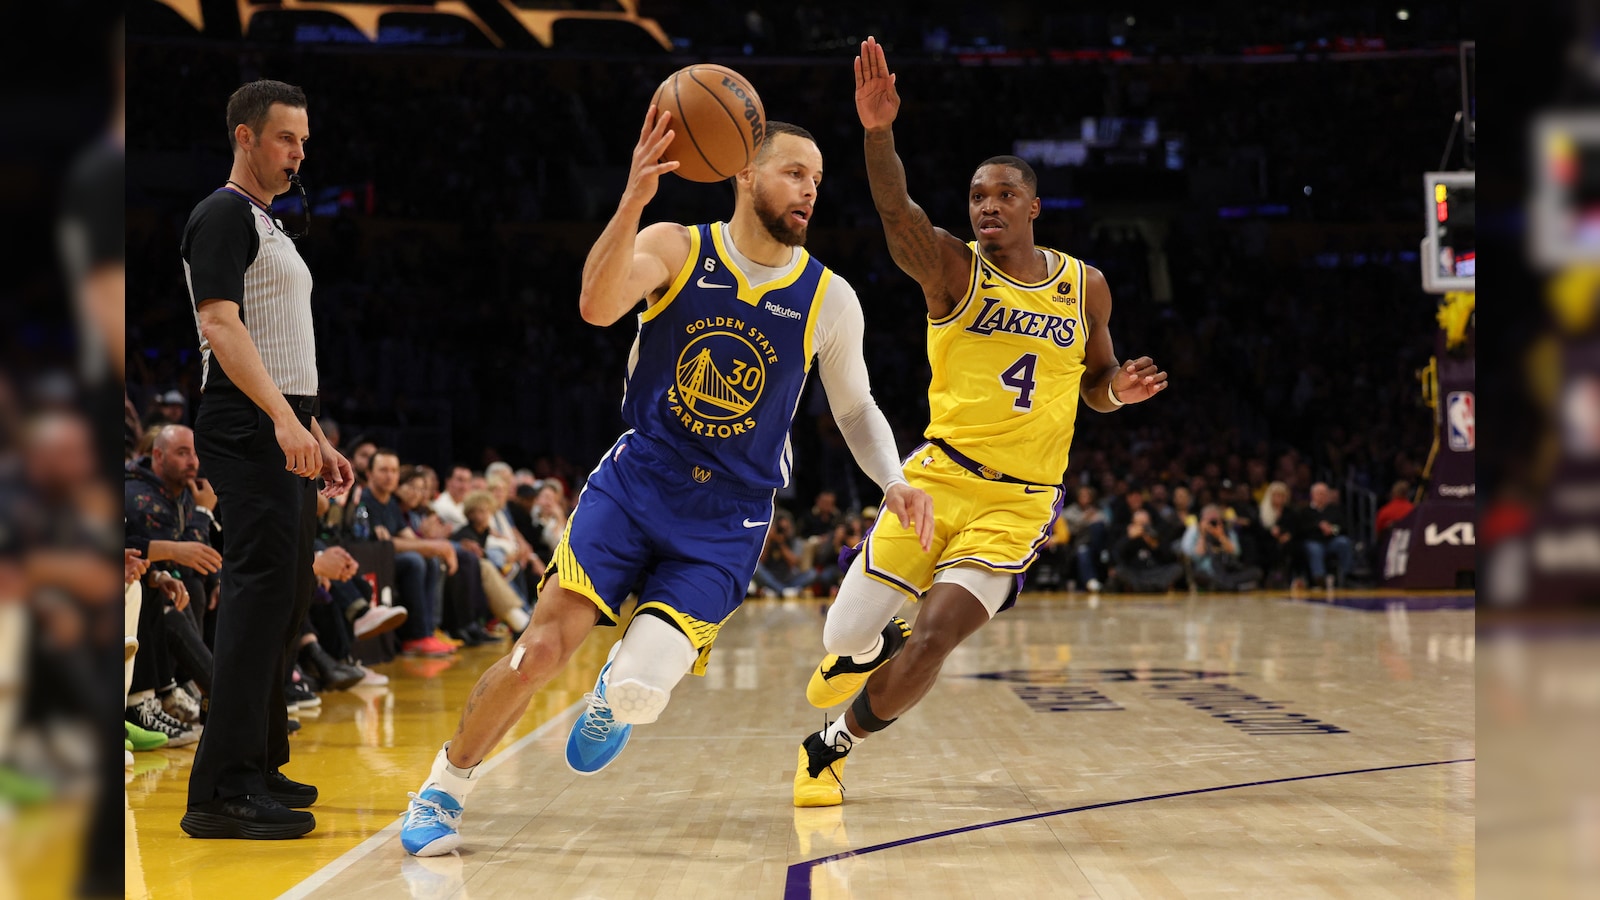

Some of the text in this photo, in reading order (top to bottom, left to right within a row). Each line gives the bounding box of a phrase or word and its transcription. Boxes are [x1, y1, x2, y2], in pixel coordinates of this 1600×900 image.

[703, 257, 716, 272] 6
[764, 301, 802, 320] Rakuten
[1052, 295, 1076, 305] bibigo
[966, 297, 1077, 348] LAKERS
[685, 317, 778, 365] GOLDEN STATE
[726, 359, 761, 391] 30
[998, 352, 1039, 412] 4
[667, 384, 757, 438] WARRIORS
[1425, 522, 1475, 546] KI
